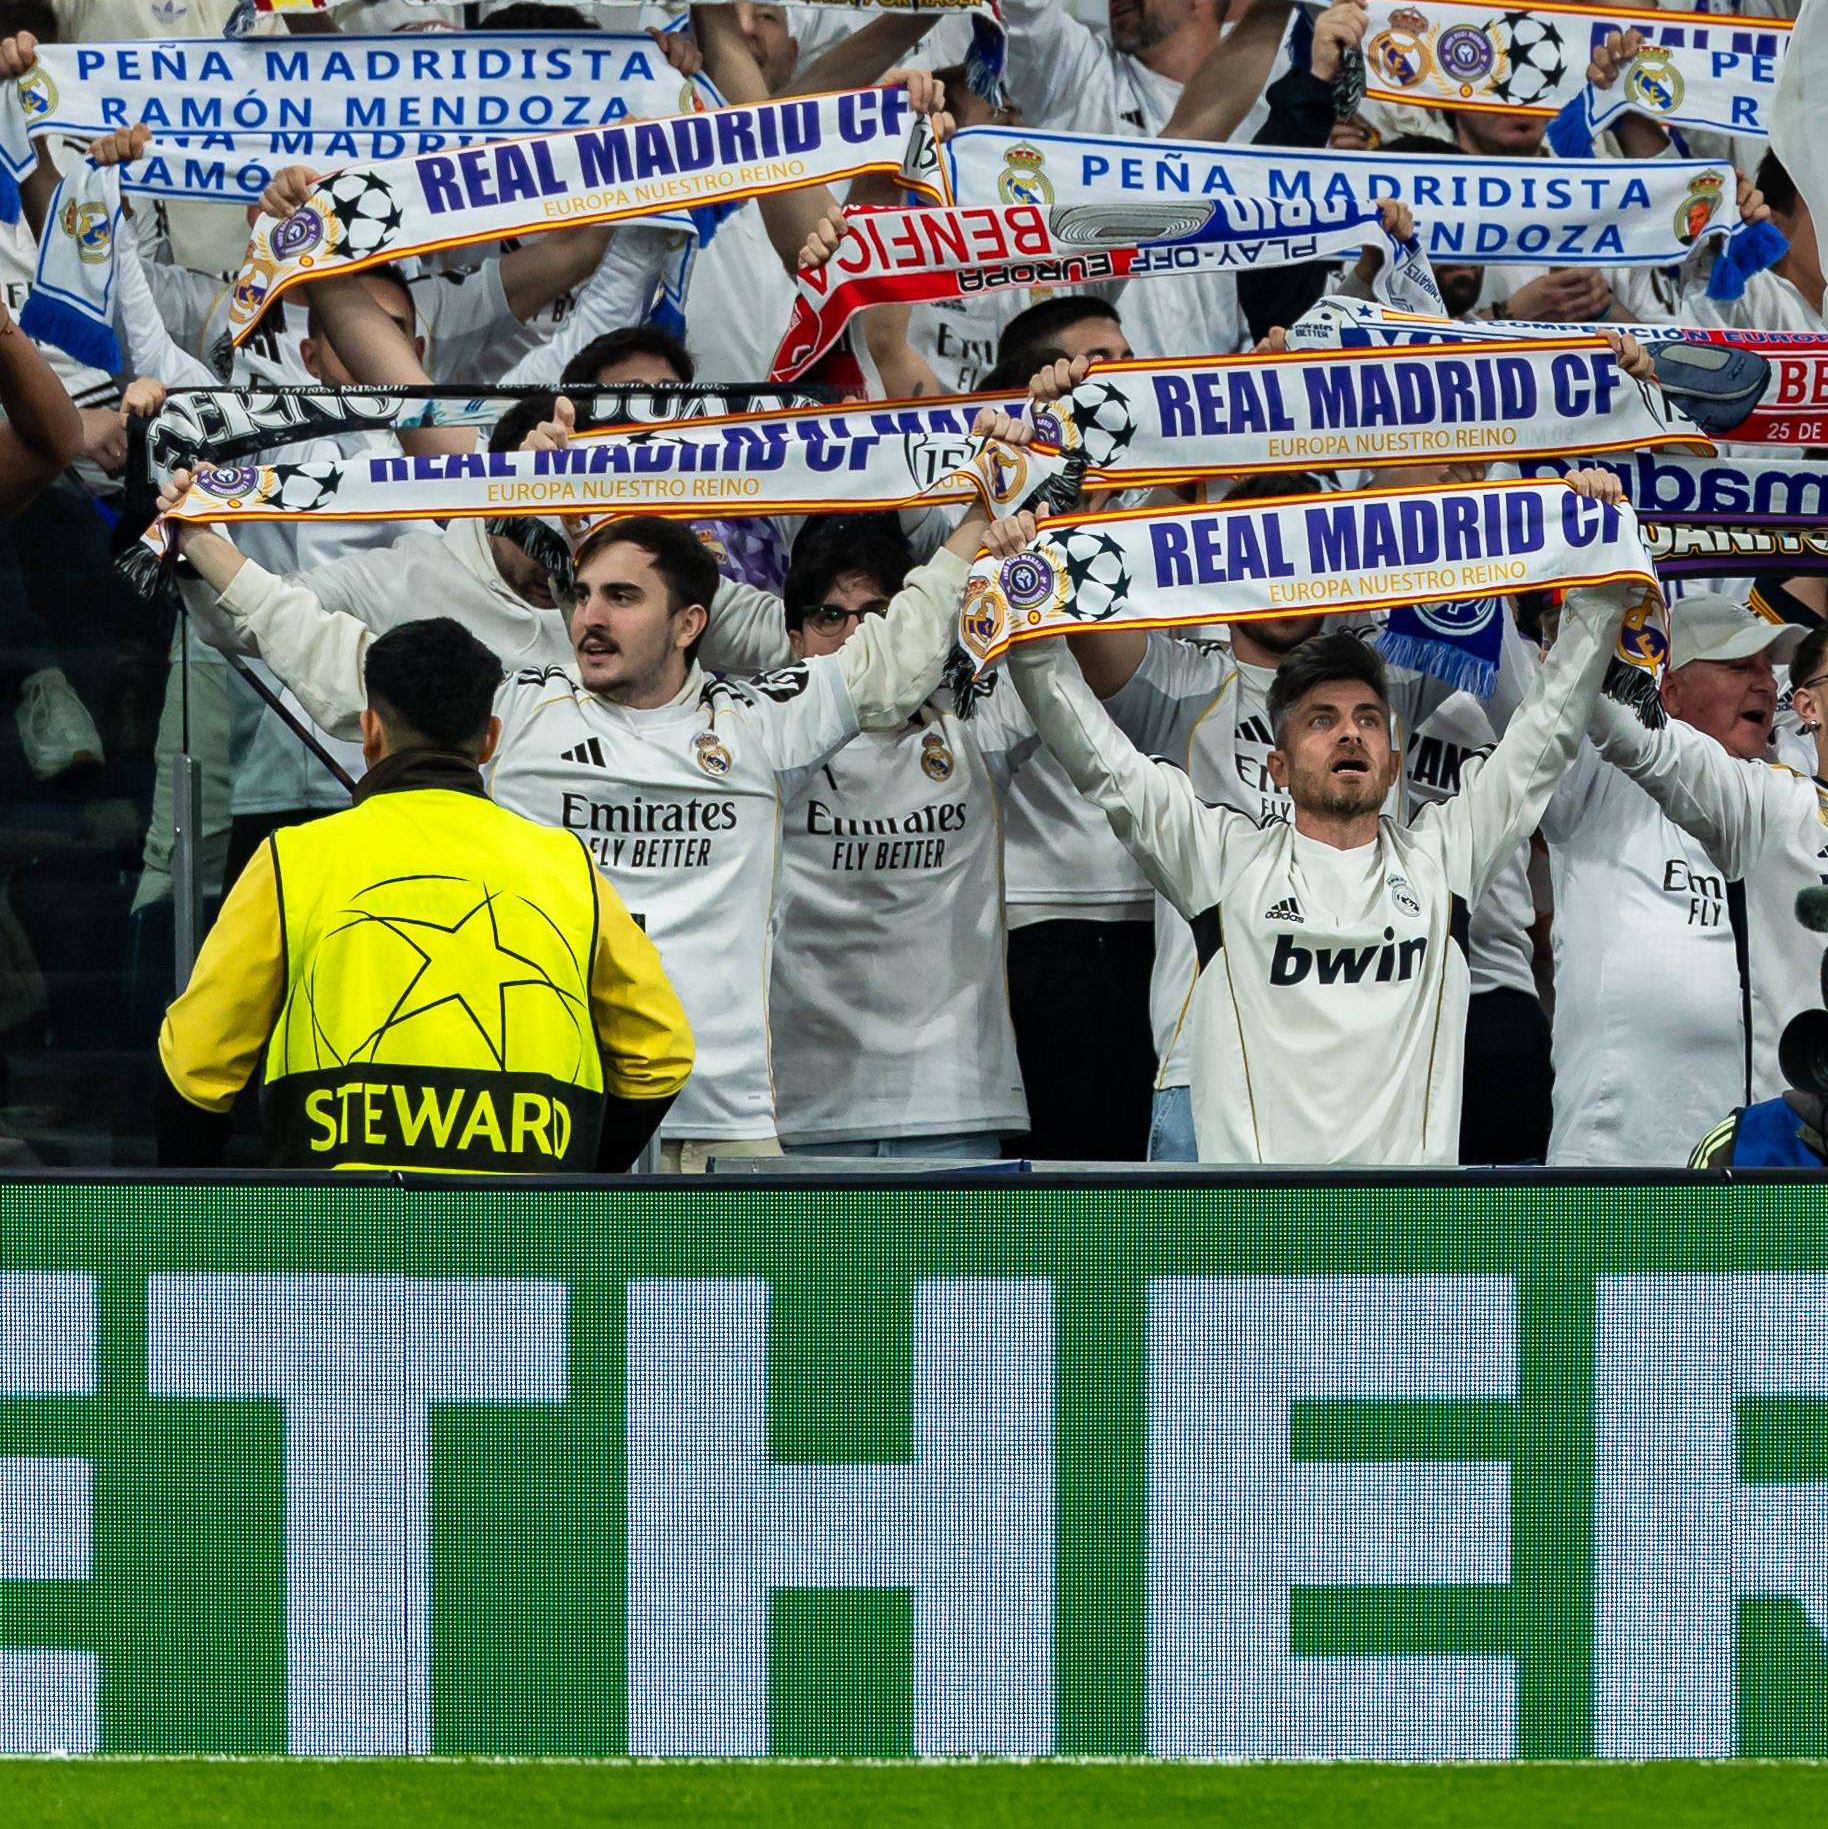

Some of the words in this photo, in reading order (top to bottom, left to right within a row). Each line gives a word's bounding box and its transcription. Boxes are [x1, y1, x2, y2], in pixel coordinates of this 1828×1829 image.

[77, 40, 234, 83] PEÑA
[265, 47, 656, 83] MADRIDISTA
[101, 87, 314, 129] RAMÓN
[346, 96, 631, 131] MENDOZA
[415, 144, 570, 217] REAL
[573, 94, 822, 189] MADRID
[544, 184, 630, 219] EUROPA
[635, 167, 735, 207] NUESTRO
[741, 158, 805, 190] REINO
[1081, 153, 1238, 198] PEÑA
[1267, 167, 1653, 210] MADRIDISTA
[1150, 369, 1294, 440] REAL
[1301, 358, 1542, 434] MADRID
[1550, 352, 1621, 418] CF
[1266, 436, 1351, 459] EUROPA
[1355, 431, 1450, 455] NUESTRO
[1453, 425, 1519, 451] REINO
[1766, 419, 1792, 441] 25
[1798, 420, 1823, 441] DE
[487, 478, 576, 503] EUROPA
[582, 477, 688, 502] NUESTRO
[693, 475, 761, 500] REINO
[1148, 512, 1296, 589] REAL
[1304, 489, 1547, 574] MADRID
[1268, 578, 1354, 603] EUROPA
[1357, 569, 1455, 597] NUESTRO
[1458, 560, 1528, 588] REINO
[562, 793, 738, 833] Emirates
[631, 837, 712, 869] BETTER
[832, 842, 868, 871] FLY
[872, 837, 946, 870] BETTER
[1269, 924, 1430, 987] bwin
[304, 1081, 573, 1161] STEWARD
